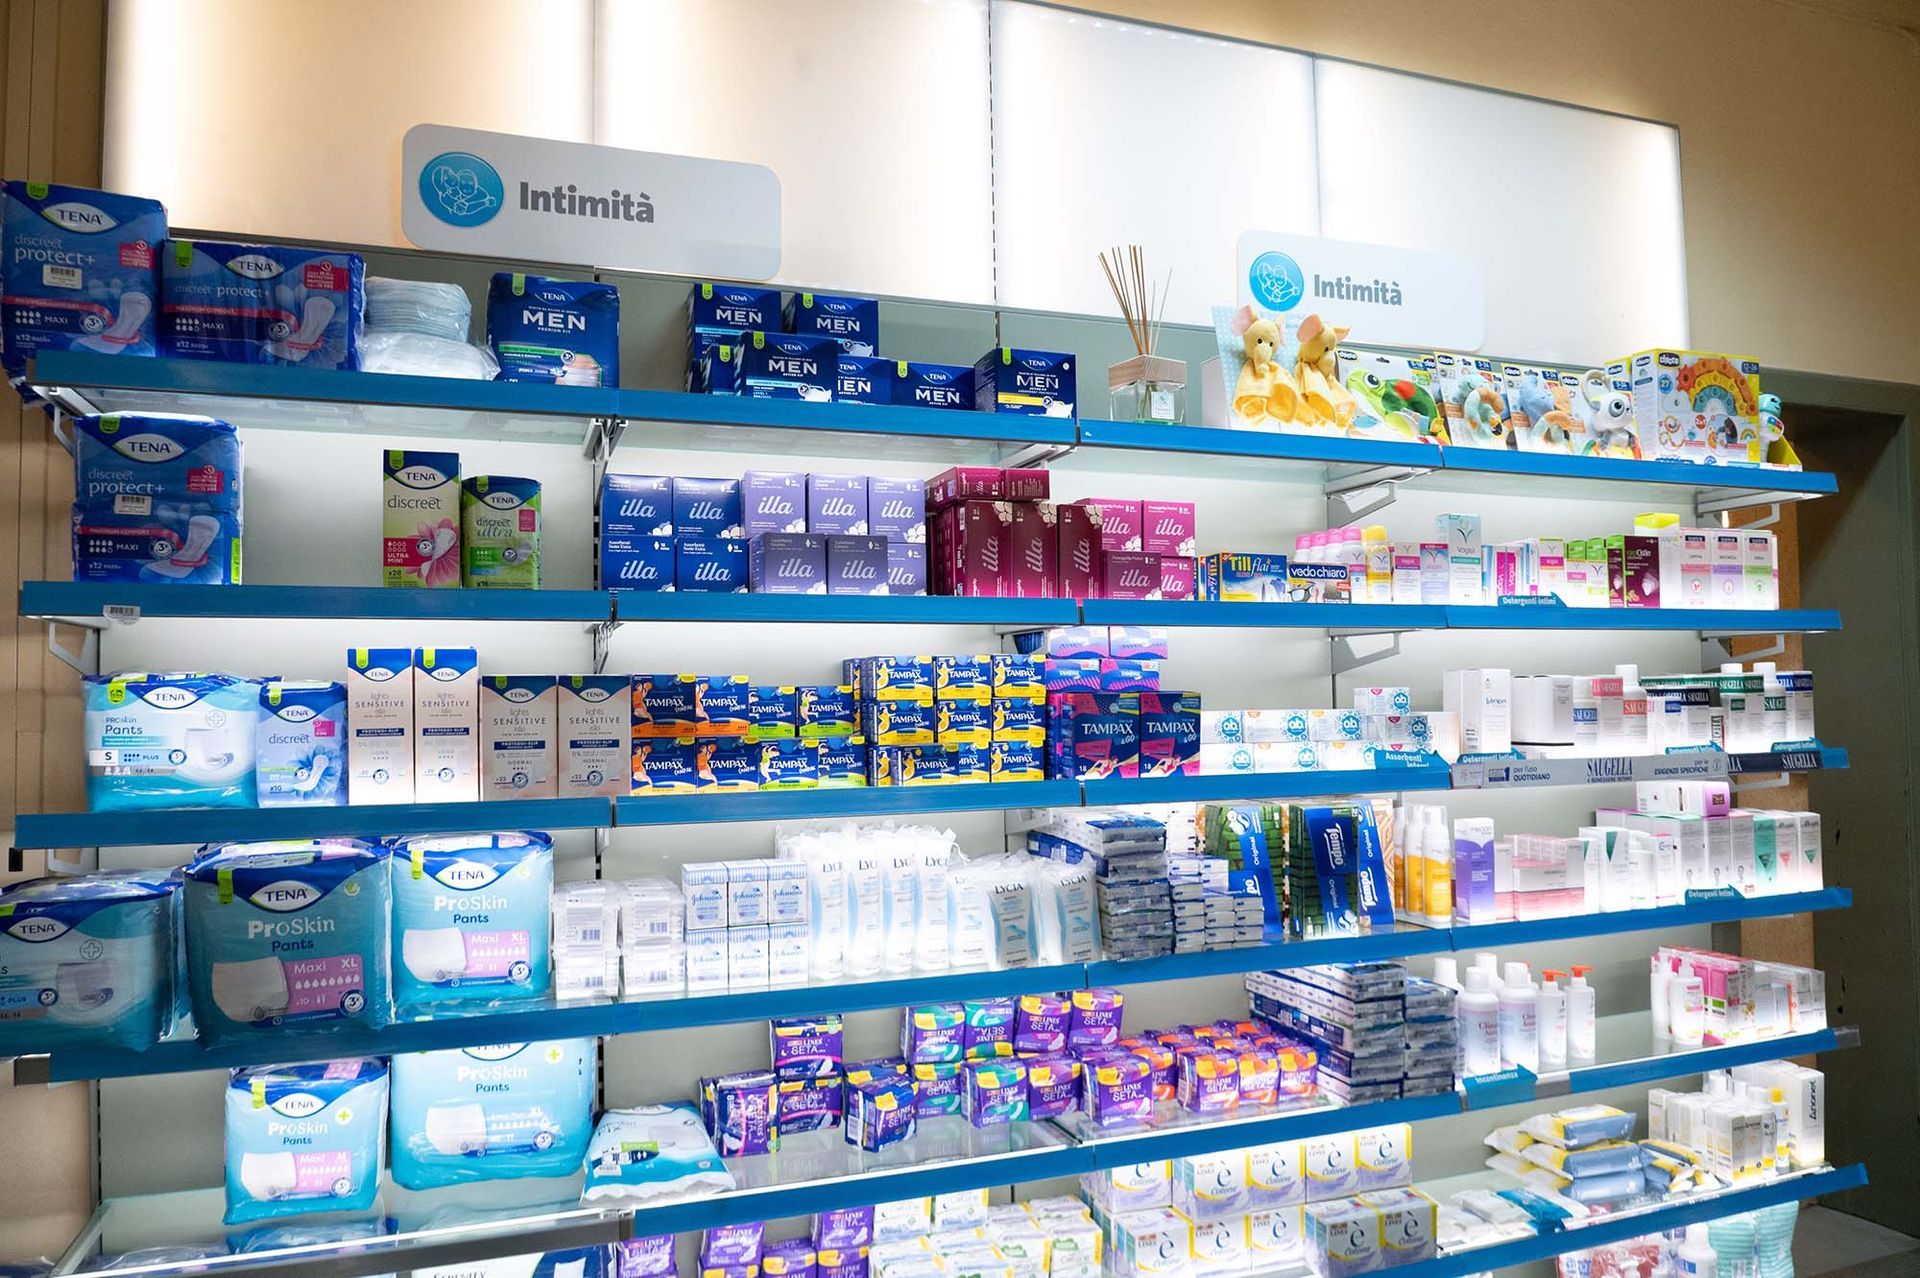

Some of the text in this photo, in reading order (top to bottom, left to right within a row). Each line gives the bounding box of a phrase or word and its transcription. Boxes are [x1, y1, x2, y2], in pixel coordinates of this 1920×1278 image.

[520, 181, 655, 224] Intimità
[58, 208, 102, 225] TENA
[14, 235, 63, 249] discreet
[15, 247, 95, 266] protect+
[238, 260, 272, 273] TENA
[175, 284, 271, 299] discreet protect+
[1314, 274, 1402, 306] Intimità
[541, 291, 568, 302] TENA
[730, 295, 748, 303] TENA
[830, 304, 847, 312] TENA
[44, 315, 69, 325] MAXI
[521, 309, 586, 333] MEN
[716, 308, 762, 325] MEN
[202, 322, 224, 332] MAXI
[816, 317, 860, 333] MEN
[783, 344, 803, 353] TENA
[768, 359, 817, 377] MEN
[839, 361, 858, 372] TENA
[1029, 361, 1046, 371] TENA
[930, 373, 946, 382] TENA
[1016, 374, 1059, 390] MEN
[915, 389, 960, 405] MEN
[128, 442, 170, 454] TENA
[88, 469, 134, 481] discreet
[406, 471, 437, 481] TENA
[88, 481, 166, 497] protect+
[387, 495, 442, 510] discreet
[491, 497, 515, 505] TENA
[757, 495, 795, 515] illa
[821, 497, 857, 517] illa
[619, 498, 657, 517] illa
[689, 501, 723, 520] illa
[881, 499, 916, 520] illa
[476, 517, 511, 528] discreet
[1155, 518, 1185, 536] illa
[476, 526, 513, 538] ultra
[116, 544, 139, 554] MAXI
[980, 535, 999, 572] illa
[620, 559, 659, 580] illa
[778, 558, 815, 579] illa
[841, 560, 877, 579] illa
[1230, 556, 1251, 573] Till
[694, 562, 732, 582] illa
[1119, 570, 1151, 588] illa
[1502, 596, 1536, 606] Detergenti
[889, 670, 921, 679] TAMPAX
[949, 669, 981, 679] TAMPAX
[155, 692, 185, 702] TENA
[644, 698, 684, 708] TAMPAX
[701, 698, 738, 707] TAMPAX
[355, 700, 404, 709] SENSITIVE
[422, 700, 470, 709] SENSITIVE
[751, 706, 784, 714] TAMPAX
[810, 703, 843, 713] TAMPAX
[285, 710, 308, 718] TENA
[493, 717, 546, 726] SENSITIVE
[569, 717, 620, 725] SENSITIVE
[1146, 721, 1196, 733] TAMPAX
[105, 724, 143, 736] Pants
[1081, 723, 1134, 735] TAMPAX
[269, 733, 311, 745] discreet
[104, 751, 113, 762] S
[821, 756, 856, 766] TAMPAX
[1386, 753, 1422, 764] Assorbenti
[1462, 755, 1499, 764] Detergenti
[1780, 755, 1818, 769] SAUGELLA
[643, 759, 684, 770] TAMPAX
[708, 758, 747, 769] TAMPAX
[771, 760, 808, 770] TAMPAX
[1586, 757, 1633, 778] SAUGELLA
[1504, 766, 1524, 781] 1 per
[1513, 773, 1551, 782] QUOTIDIANO
[1325, 824, 1345, 868] Tempo
[1362, 829, 1374, 858] Original
[1249, 836, 1260, 866] Original
[450, 870, 485, 881] TENA
[1060, 875, 1088, 886] LYCIA
[995, 883, 1024, 894] LYCIA
[1328, 878, 1340, 909] Original
[1360, 868, 1379, 911] Tempo
[1688, 889, 1718, 898] Detergenti
[265, 888, 306, 902] TENA
[434, 896, 508, 911] ProSkin
[453, 913, 489, 924] Pants
[19, 923, 56, 935] TENA
[248, 917, 335, 939] ProSkin
[472, 934, 499, 944] Maxi
[511, 933, 526, 942] XL
[272, 938, 314, 952] Pants
[294, 961, 326, 974] Maxi
[341, 958, 358, 969] XL
[1030, 1022, 1054, 1032] SETA
[1083, 1017, 1107, 1026] SETA
[791, 1044, 819, 1055] SETA
[457, 1066, 527, 1082] ProSkin
[475, 1082, 510, 1094] Pants
[926, 1086, 951, 1096] SETA
[990, 1095, 1015, 1105] SETA
[1042, 1091, 1068, 1101] SETA
[793, 1100, 820, 1111] SETA
[888, 1115, 910, 1127] SETA
[268, 1121, 328, 1136] ProSkin
[283, 1136, 312, 1145] Pants
[300, 1154, 325, 1163] Maxi
[1272, 1213, 1287, 1240] è
[1215, 1222, 1231, 1249] è
